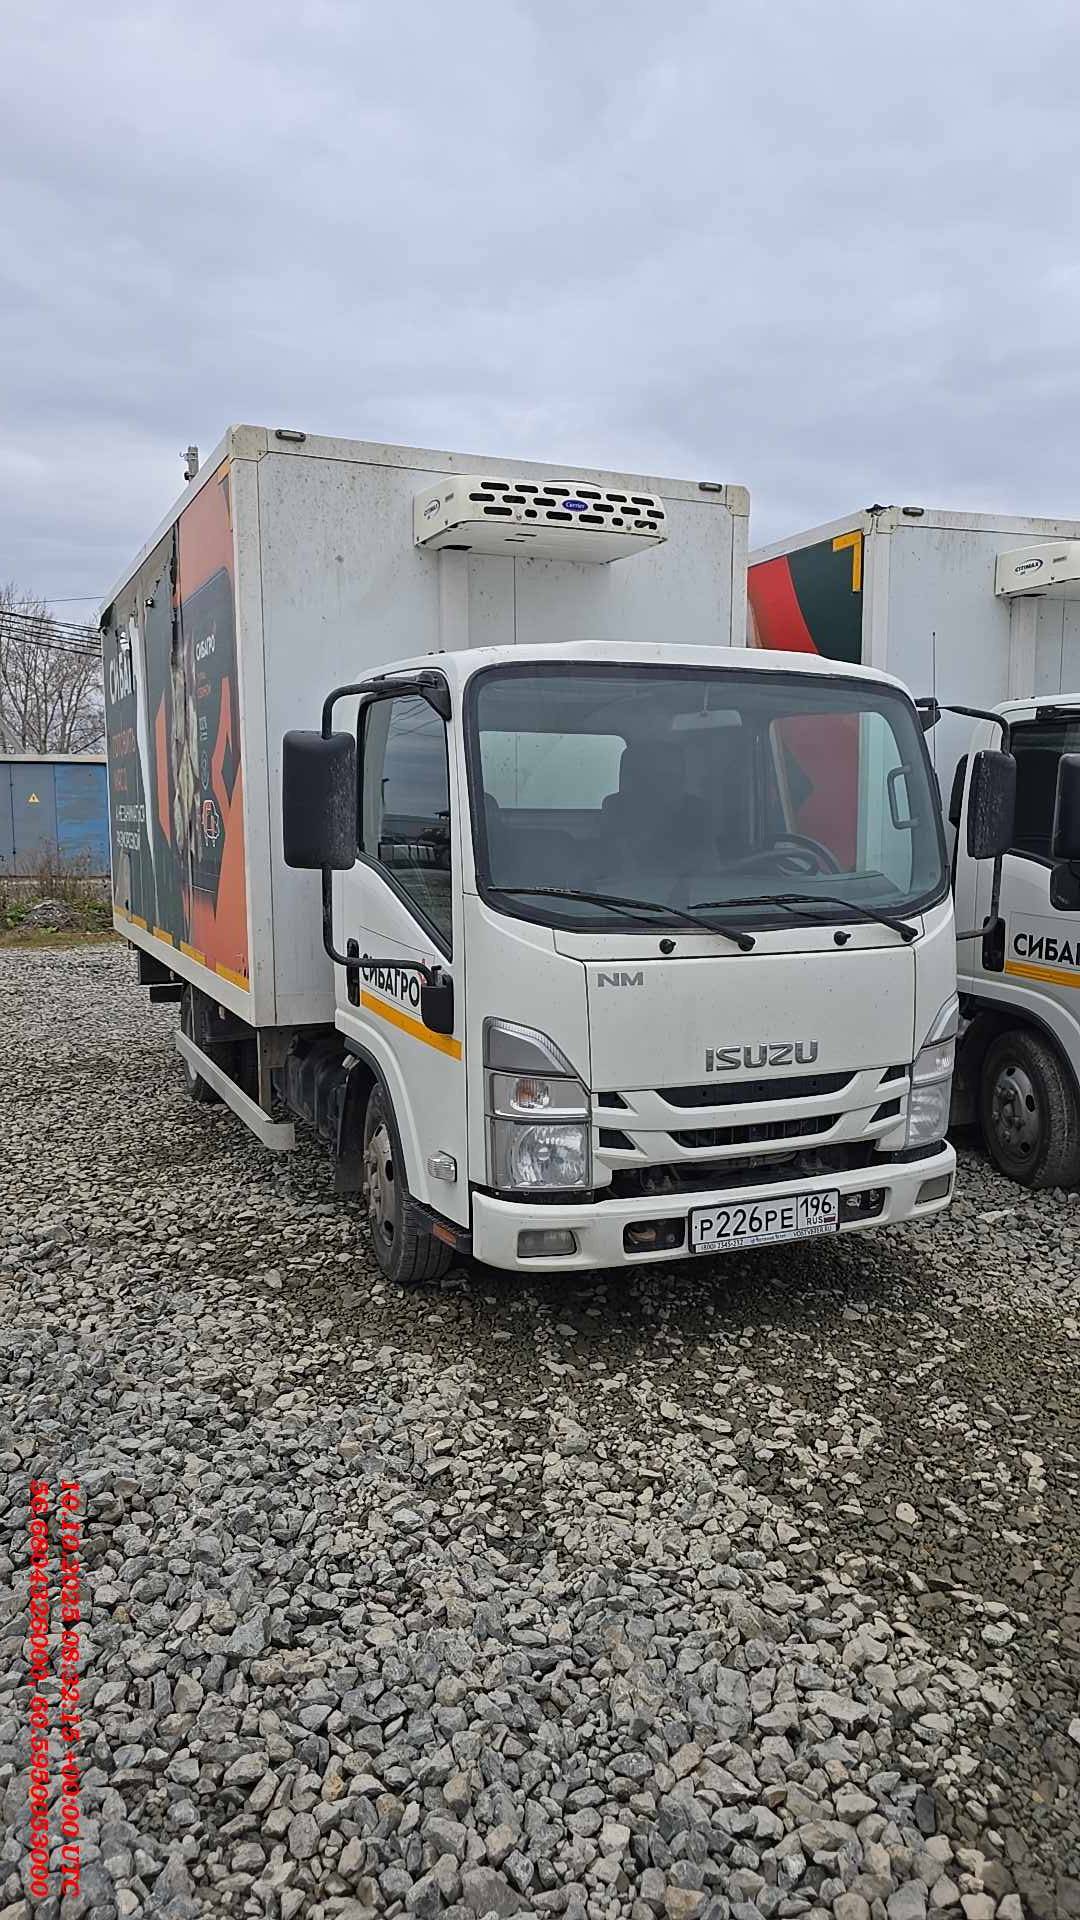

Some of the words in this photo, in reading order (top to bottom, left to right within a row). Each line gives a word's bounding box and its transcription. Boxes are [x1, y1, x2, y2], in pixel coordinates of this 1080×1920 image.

[597, 971, 644, 988] NM
[705, 1040, 818, 1073] ISUZU
[700, 1206, 793, 1241] Р226РЕ
[800, 1194, 832, 1218] 196
[806, 1216, 823, 1225] RUS
